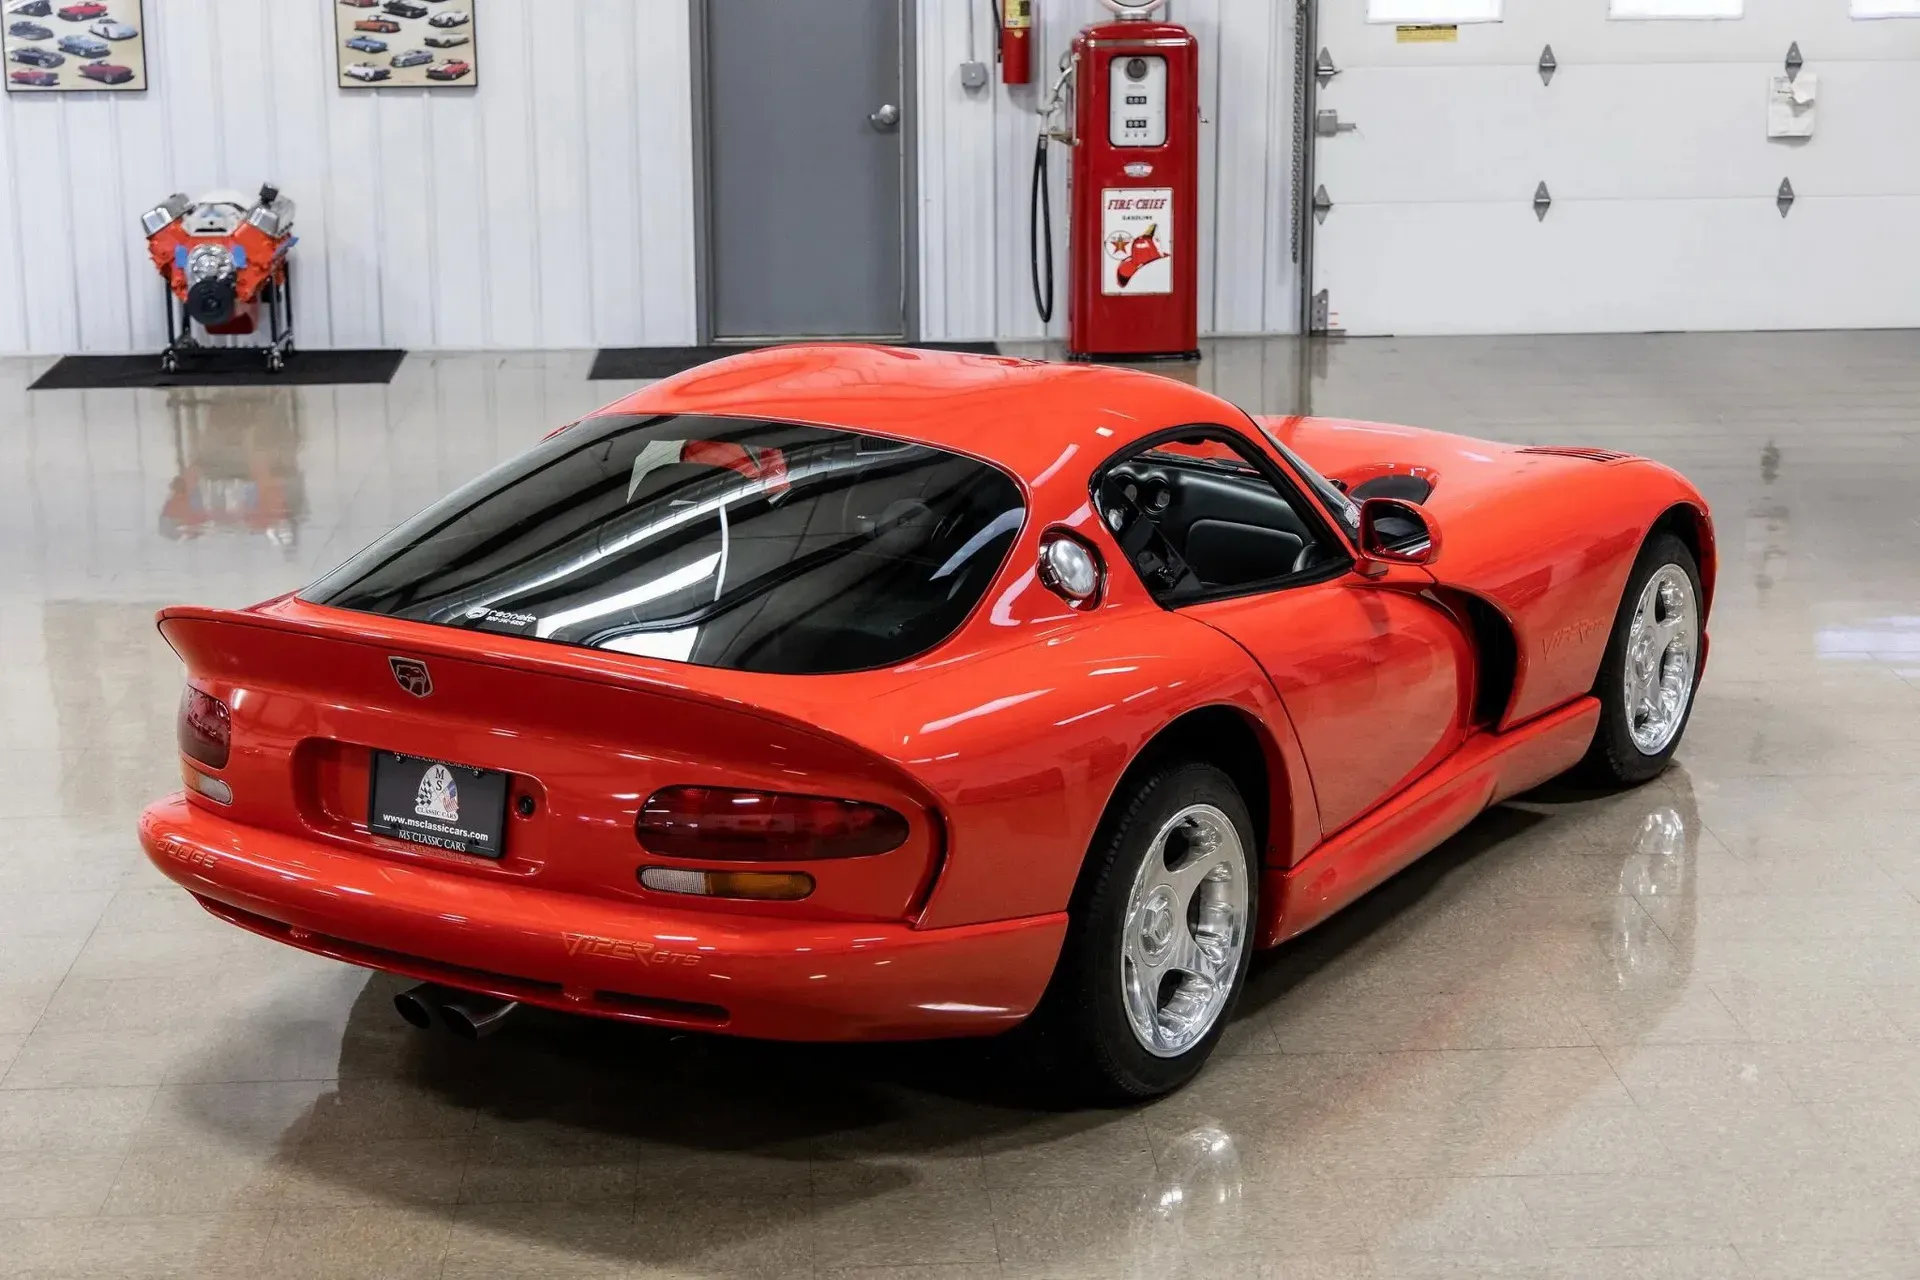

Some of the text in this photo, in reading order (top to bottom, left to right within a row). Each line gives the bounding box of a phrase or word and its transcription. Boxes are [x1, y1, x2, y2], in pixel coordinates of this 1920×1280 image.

[1107, 198, 1167, 211] FIRE-CHIEF
[435, 767, 445, 780] M
[435, 780, 443, 792] S
[416, 806, 458, 820] CLASSIC CARS
[382, 813, 490, 842] www.msclassiccars.com
[398, 829, 467, 853] MS CLASSIC CARS
[560, 931, 703, 968] VIPER GTS
